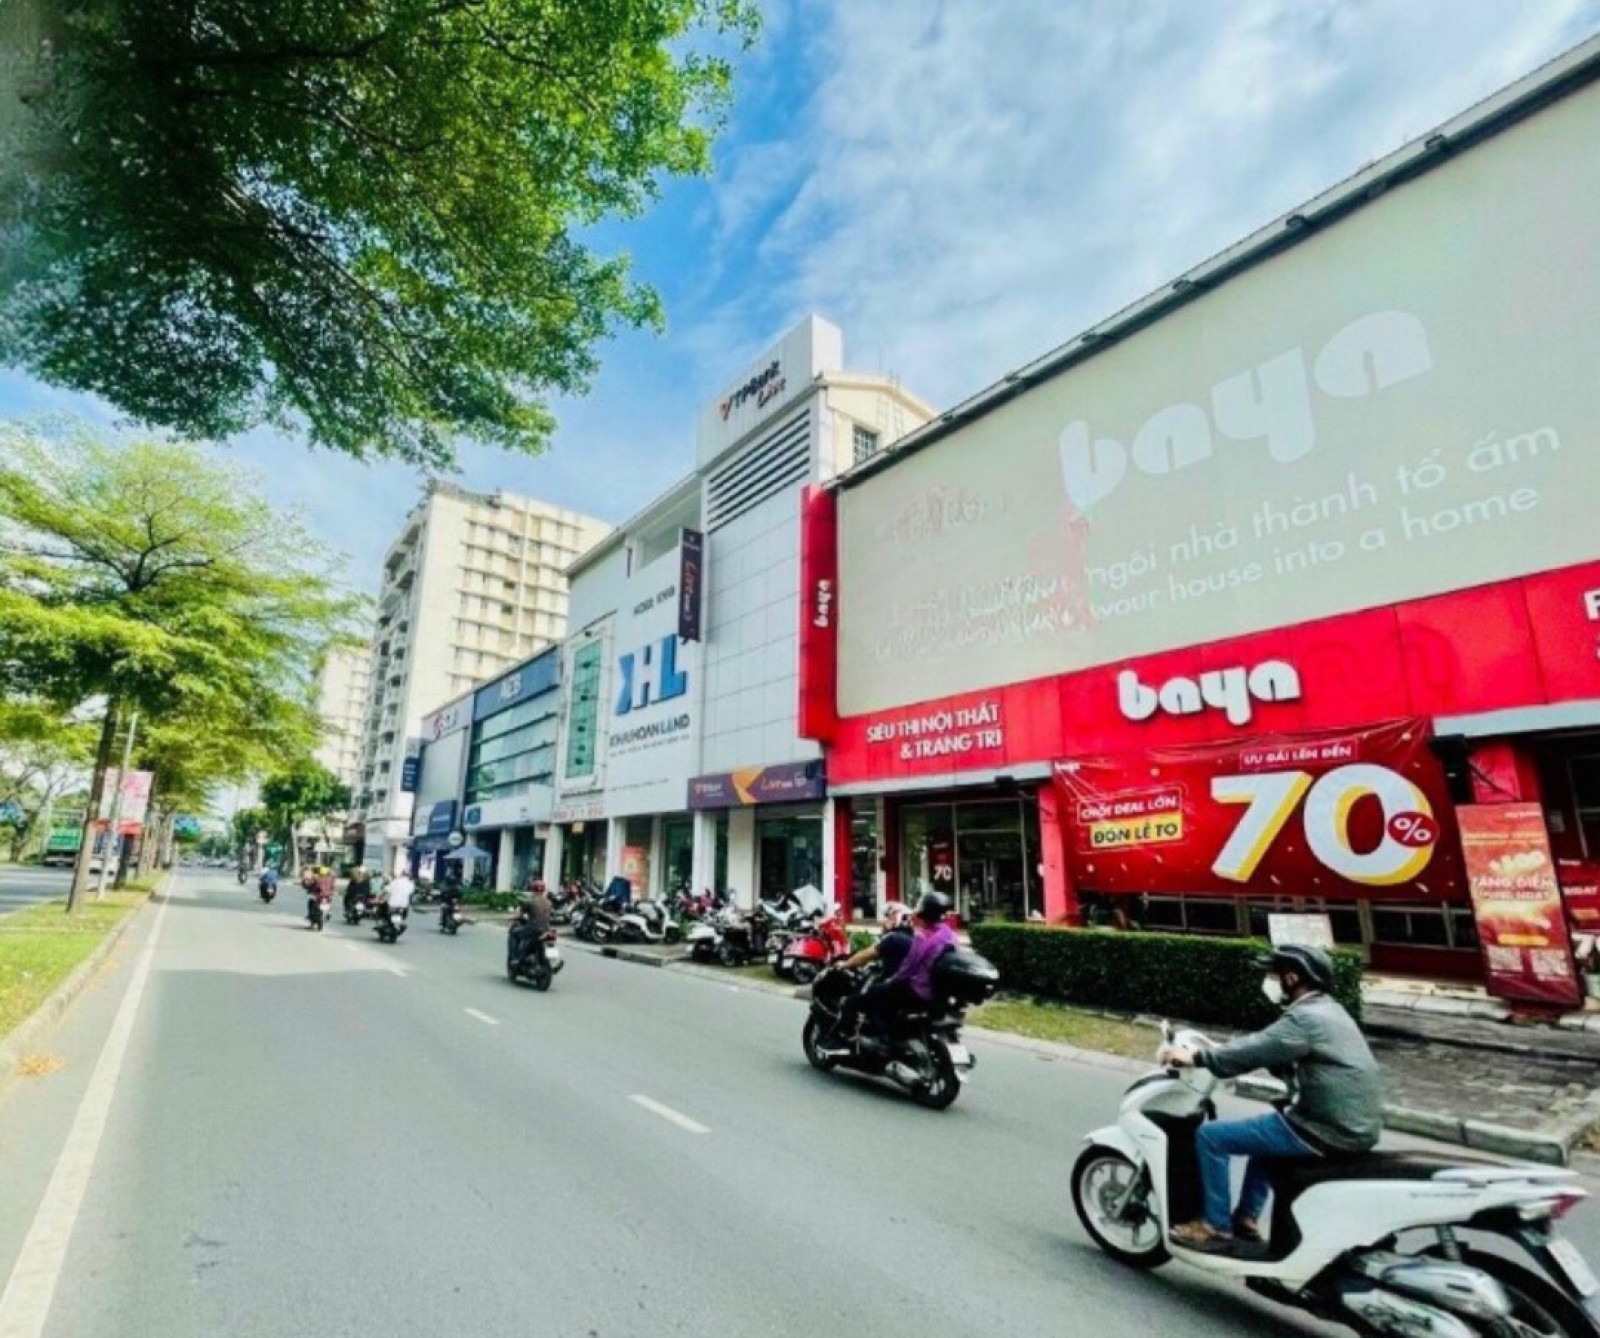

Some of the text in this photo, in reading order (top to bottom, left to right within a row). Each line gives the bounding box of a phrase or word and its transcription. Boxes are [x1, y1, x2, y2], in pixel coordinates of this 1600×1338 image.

[1059, 310, 1433, 513] baya
[1170, 522, 1238, 564] nhà
[1252, 470, 1378, 539] thành
[1467, 426, 1560, 472] ấm
[1167, 571, 1264, 602] house
[1274, 540, 1345, 576] into
[1359, 528, 1386, 551] a
[1401, 485, 1539, 540] home
[1117, 659, 1302, 726] baya
[915, 732, 973, 757] TRANG
[1156, 822, 1179, 838] TO
